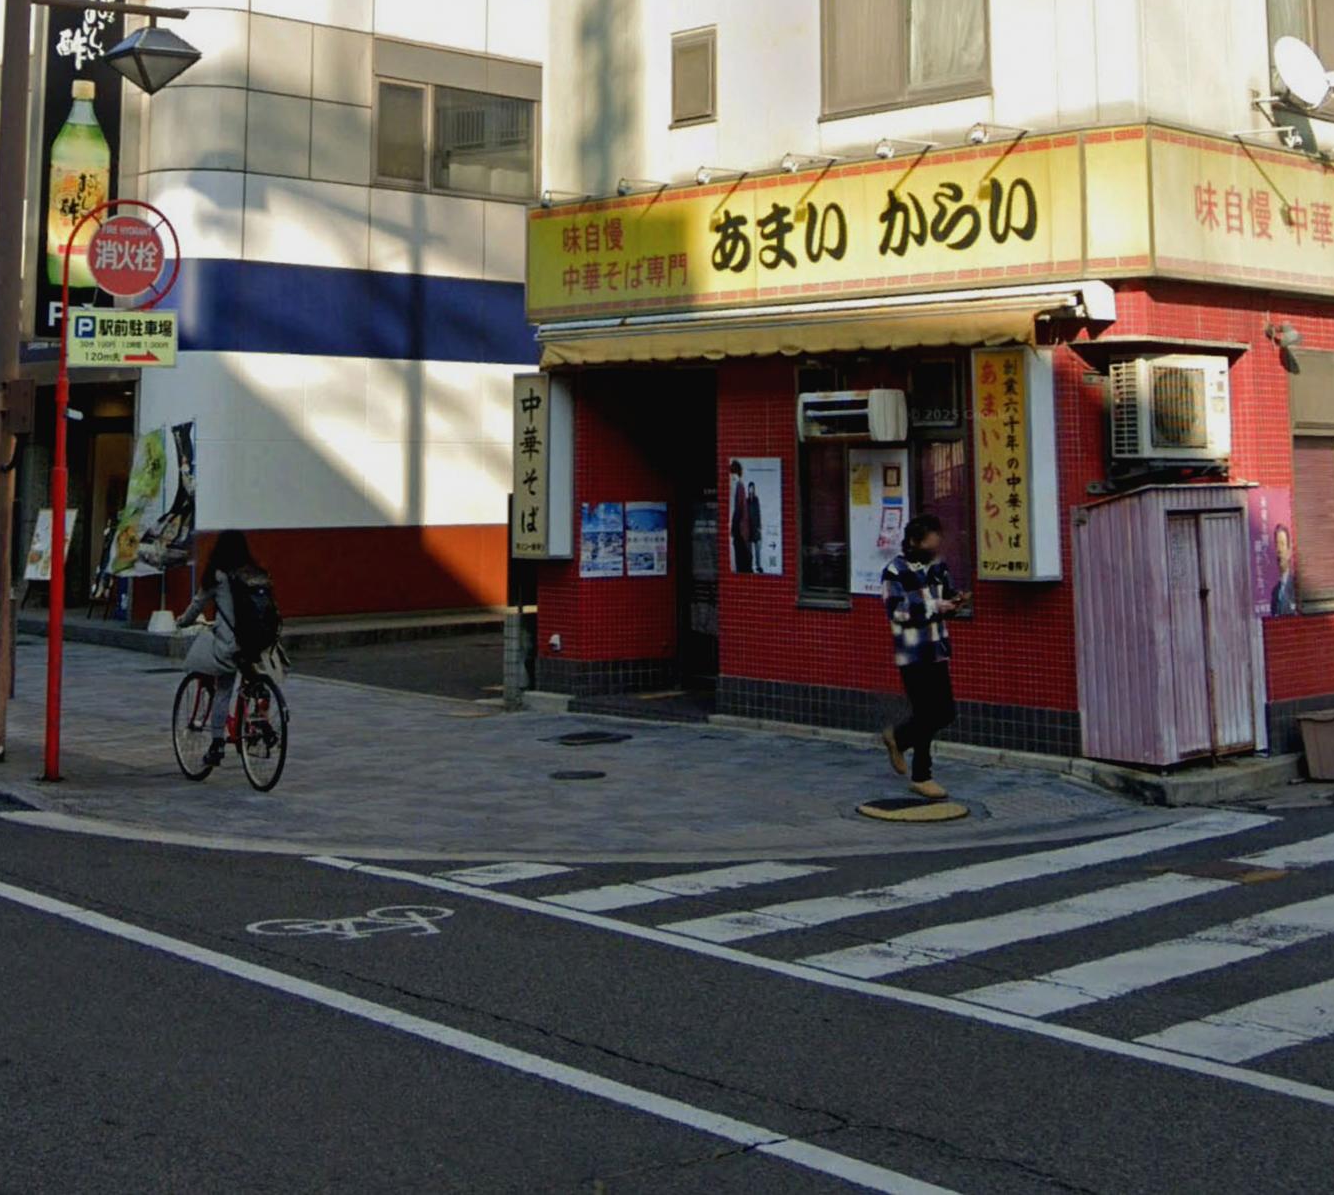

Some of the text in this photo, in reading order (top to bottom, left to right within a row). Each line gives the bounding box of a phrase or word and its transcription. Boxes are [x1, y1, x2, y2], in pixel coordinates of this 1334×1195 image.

[562, 217, 624, 255] 味自慢
[711, 176, 1038, 273] あまい からい
[1193, 179, 1273, 241] 味自慢
[95, 238, 159, 272] 消火栓
[562, 252, 688, 297] 中華そば専門
[98, 318, 173, 338] 駅前駐車場
[519, 383, 543, 534] 中華そば
[980, 359, 1004, 550] あまいからい
